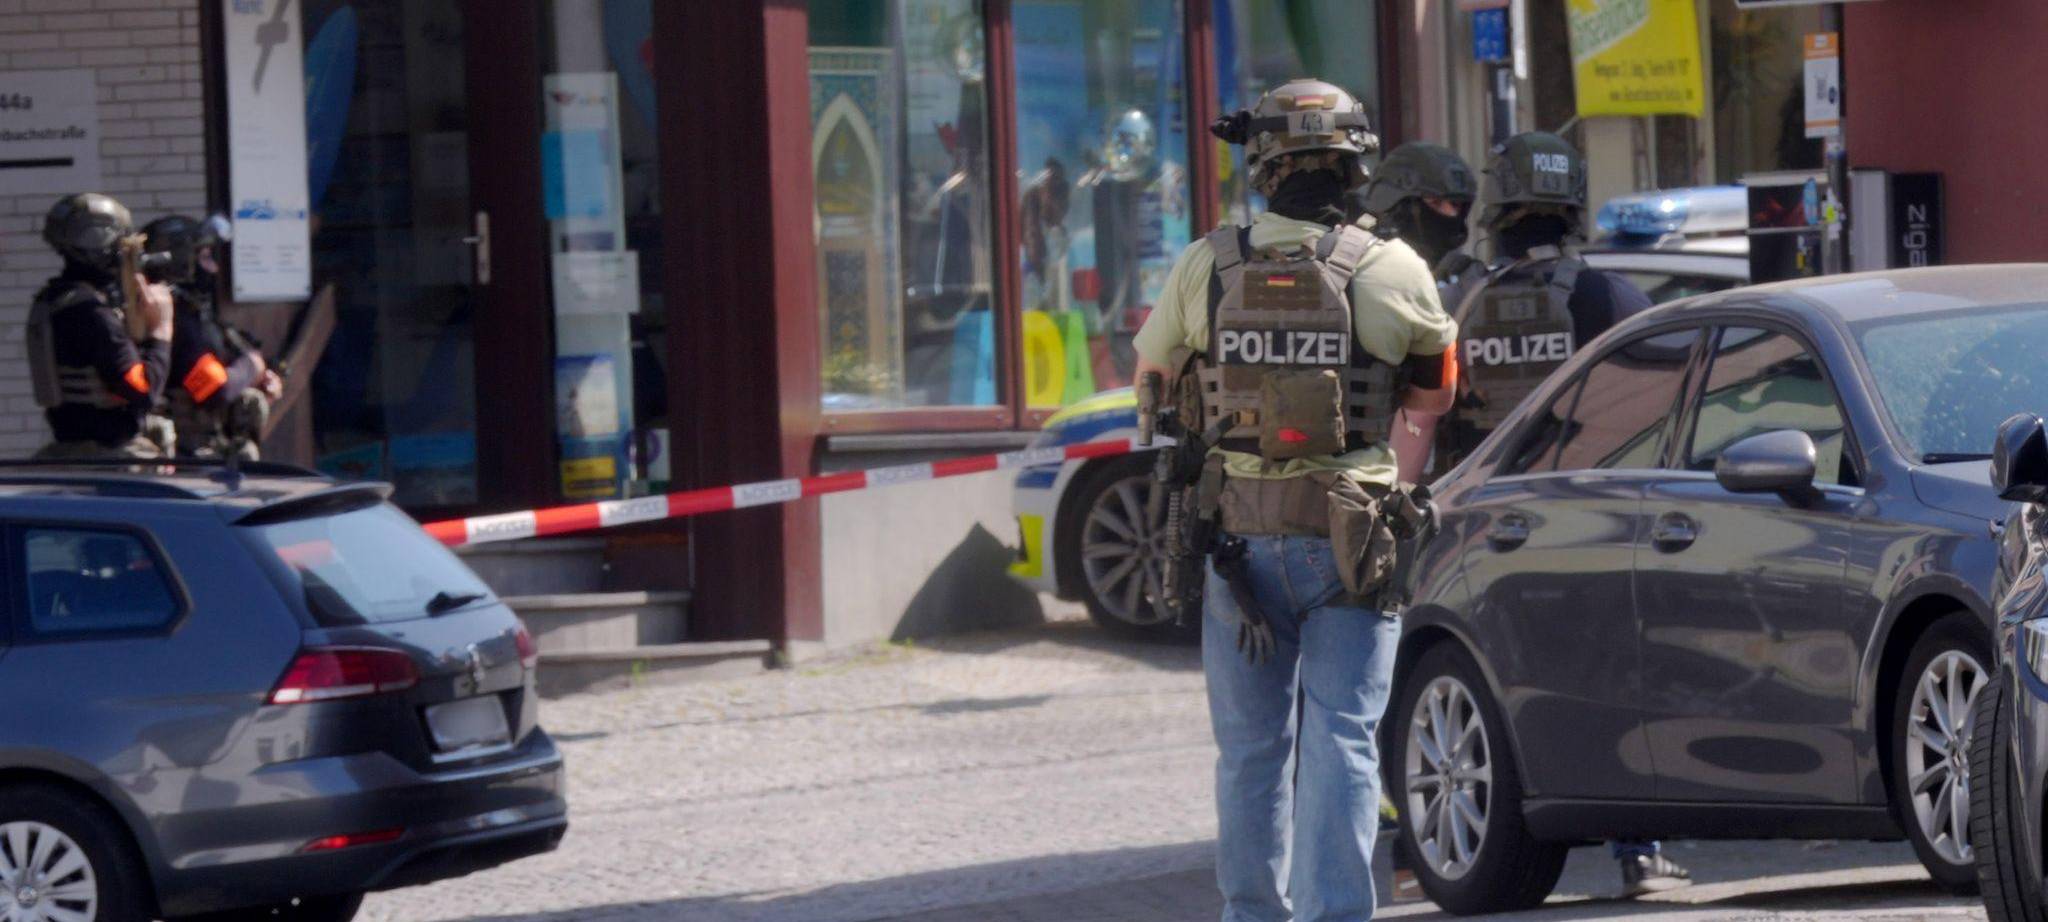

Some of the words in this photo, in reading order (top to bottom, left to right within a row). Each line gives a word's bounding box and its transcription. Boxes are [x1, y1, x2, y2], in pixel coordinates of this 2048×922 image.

[1301, 114, 1323, 132] 43
[1533, 153, 1568, 174] POLIZEI
[1219, 331, 1347, 363] POLIZEI
[1465, 333, 1571, 366] POLIZEI
